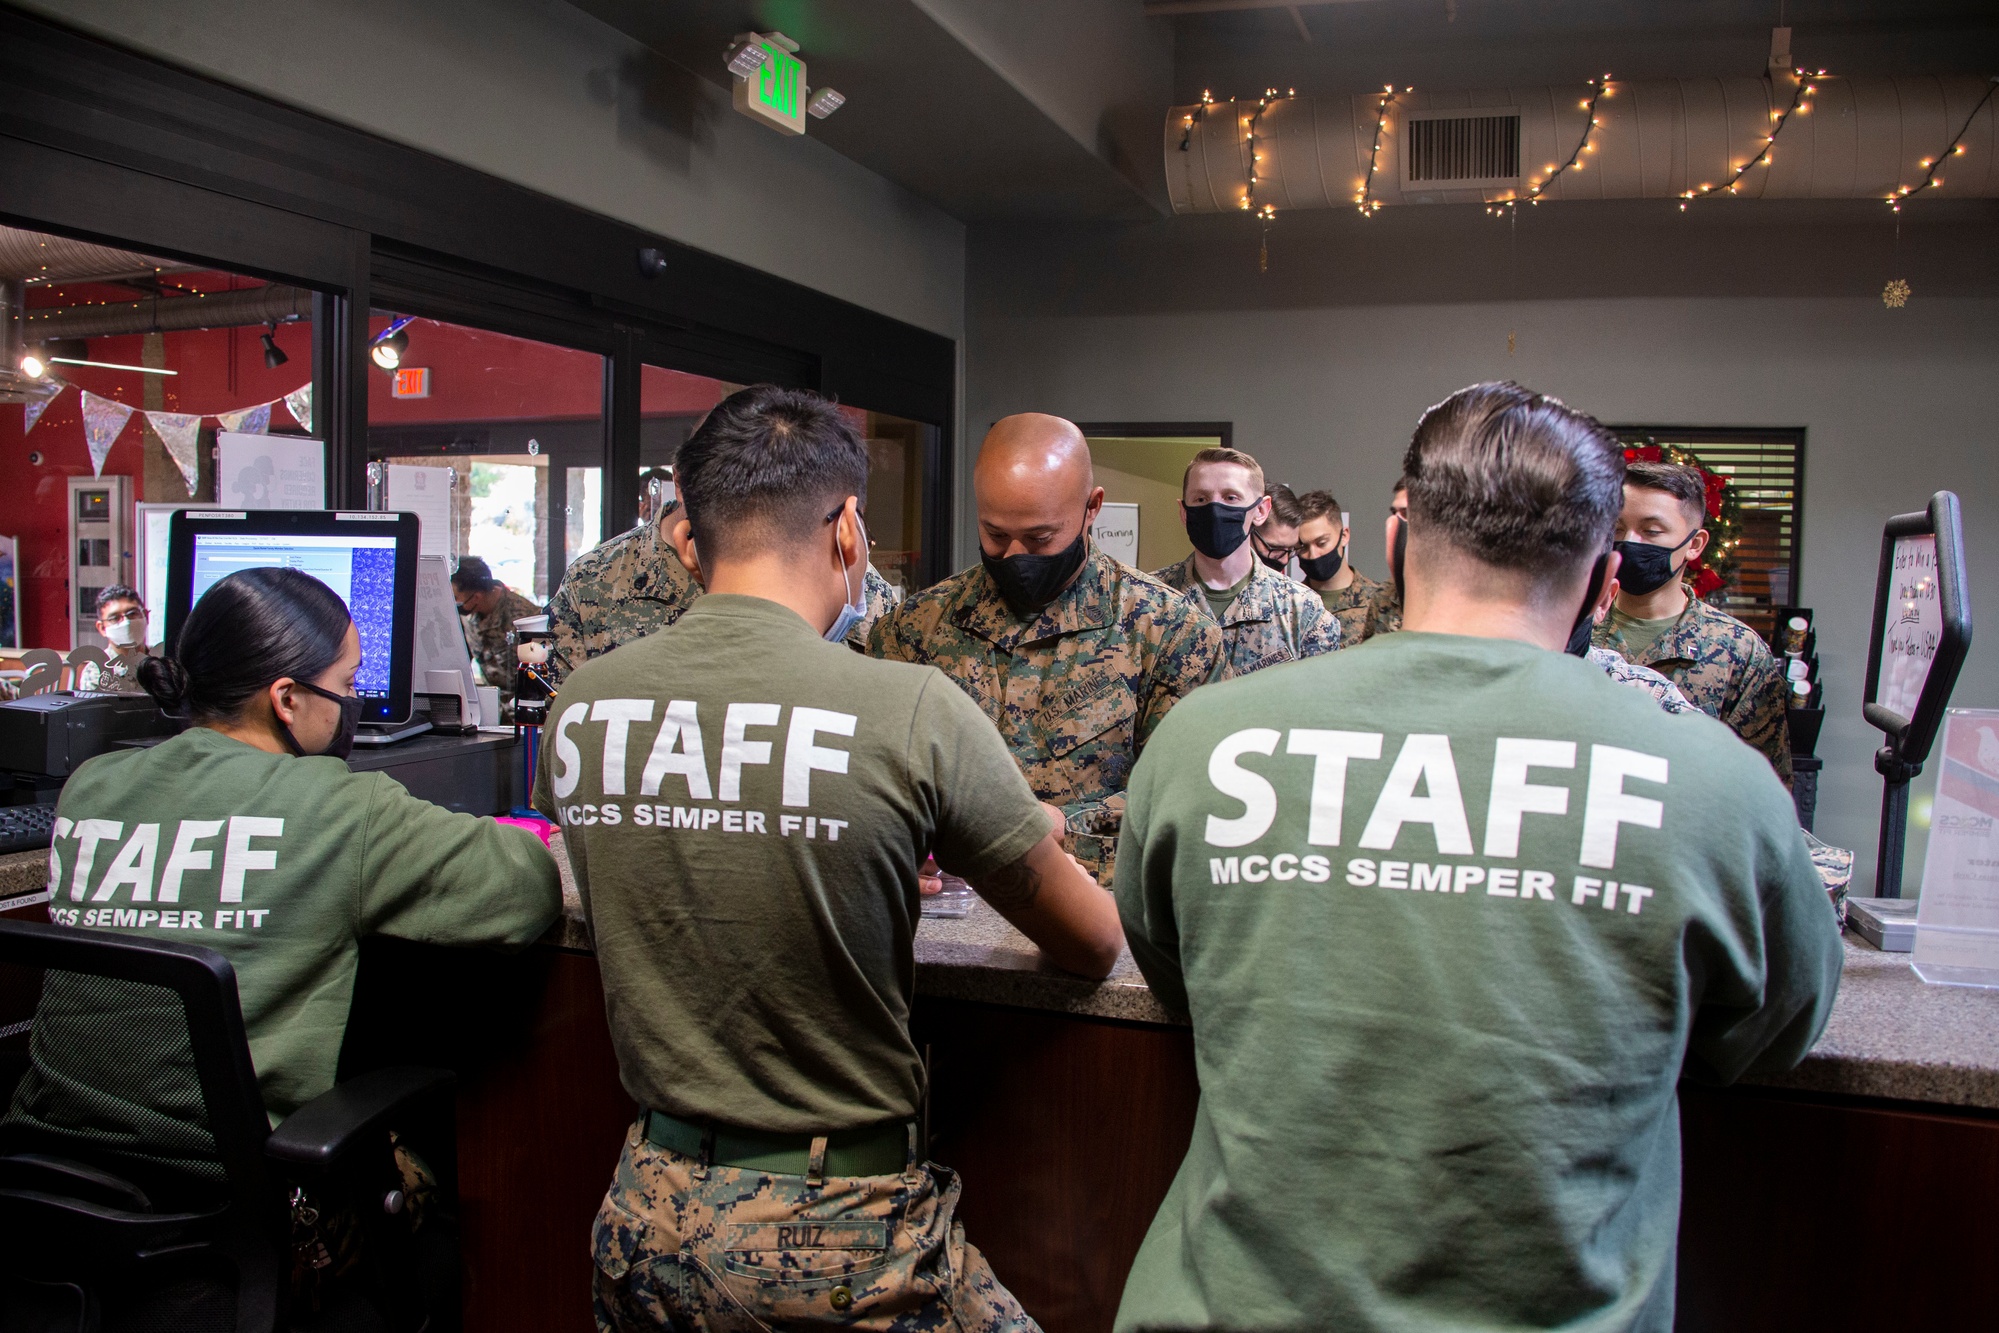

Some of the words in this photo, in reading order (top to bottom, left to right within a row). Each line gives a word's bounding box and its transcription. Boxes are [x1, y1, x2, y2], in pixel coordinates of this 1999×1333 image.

[759, 40, 801, 119] EXIT
[397, 368, 424, 395] EXIT
[1095, 526, 1134, 547] Training
[1249, 651, 1284, 673] MARINES
[1043, 705, 1062, 722] U.S.
[1063, 670, 1110, 708] MARINES
[554, 698, 858, 807] STAFF
[1204, 728, 1669, 869] STAFF
[633, 804, 767, 834] SEMPER
[780, 814, 849, 841] FIT
[48, 816, 285, 903] STAFF
[16, 896, 37, 906] FOUND
[1209, 853, 1331, 884] MCCS
[1346, 858, 1555, 900] SEMPER
[1572, 875, 1654, 915] FIT
[49, 907, 80, 927] CCS
[83, 908, 204, 929] SEMPER
[214, 909, 270, 929] FIT
[778, 1226, 825, 1248] RUIZ
